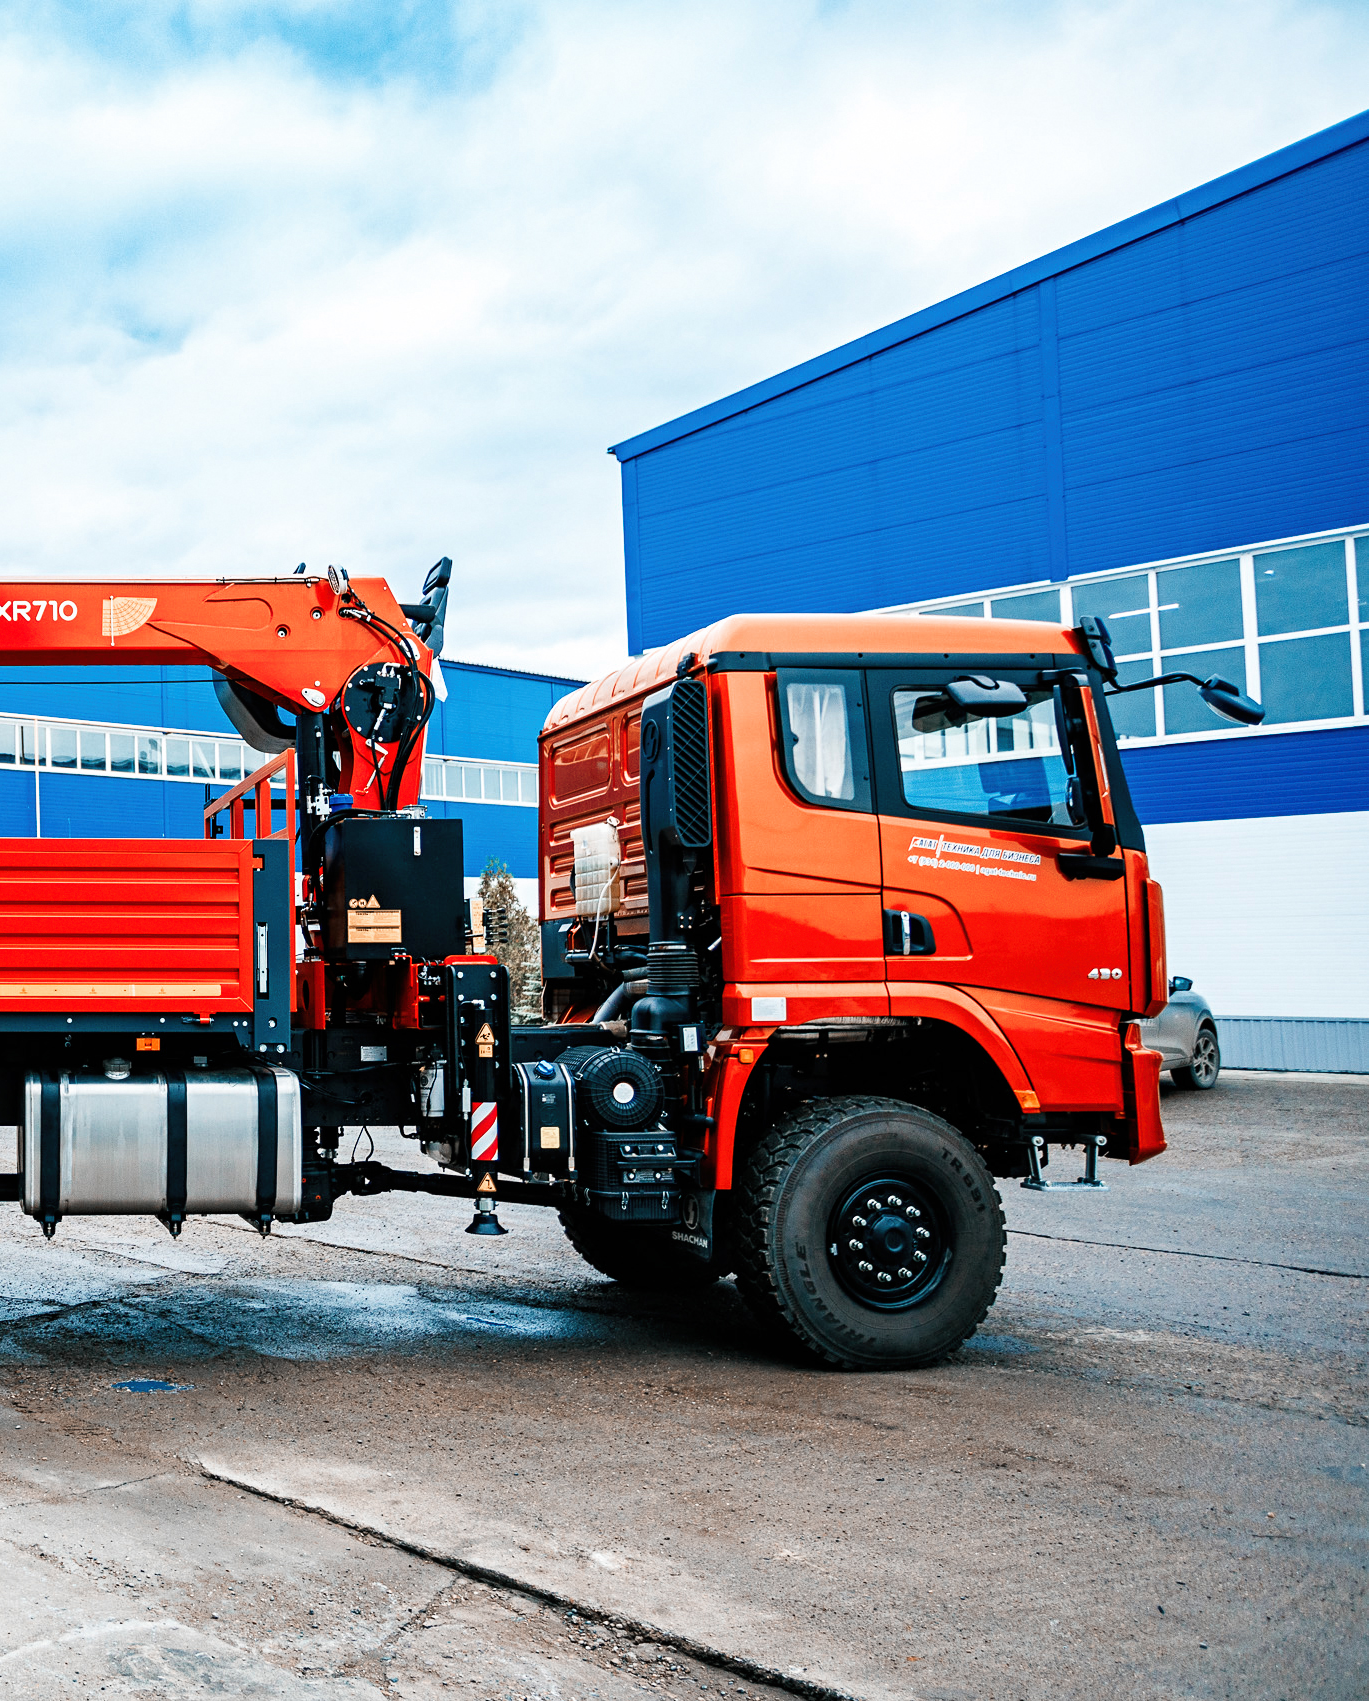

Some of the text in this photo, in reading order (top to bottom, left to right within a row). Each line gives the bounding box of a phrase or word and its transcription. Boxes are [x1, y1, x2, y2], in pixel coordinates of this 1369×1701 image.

[942, 842, 981, 856] ТЕХНИКА
[980, 847, 1002, 859] ДЛЯ
[1001, 850, 1041, 865] БИЗНЕСА
[1087, 967, 1123, 980] 430
